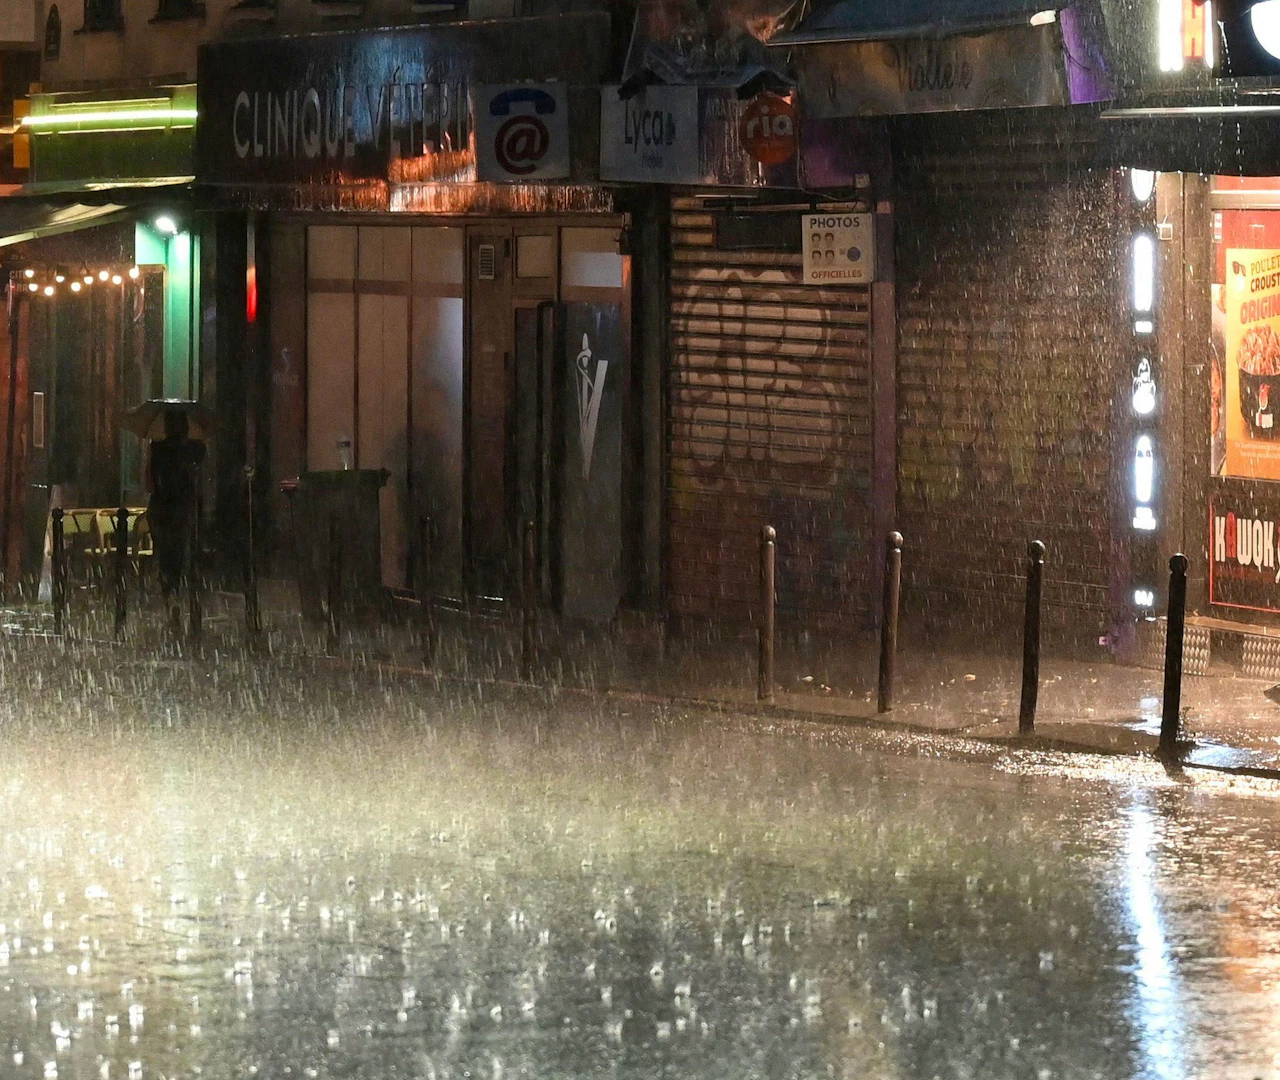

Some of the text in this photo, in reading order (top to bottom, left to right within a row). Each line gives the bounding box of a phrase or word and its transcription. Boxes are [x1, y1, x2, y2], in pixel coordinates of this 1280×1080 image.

[233, 85, 356, 159] CLINIQUE
[747, 105, 794, 138] ria
[810, 217, 860, 229] PHOTOS
[811, 269, 863, 279] OFFICIELLES
[1250, 254, 1280, 276] POULET
